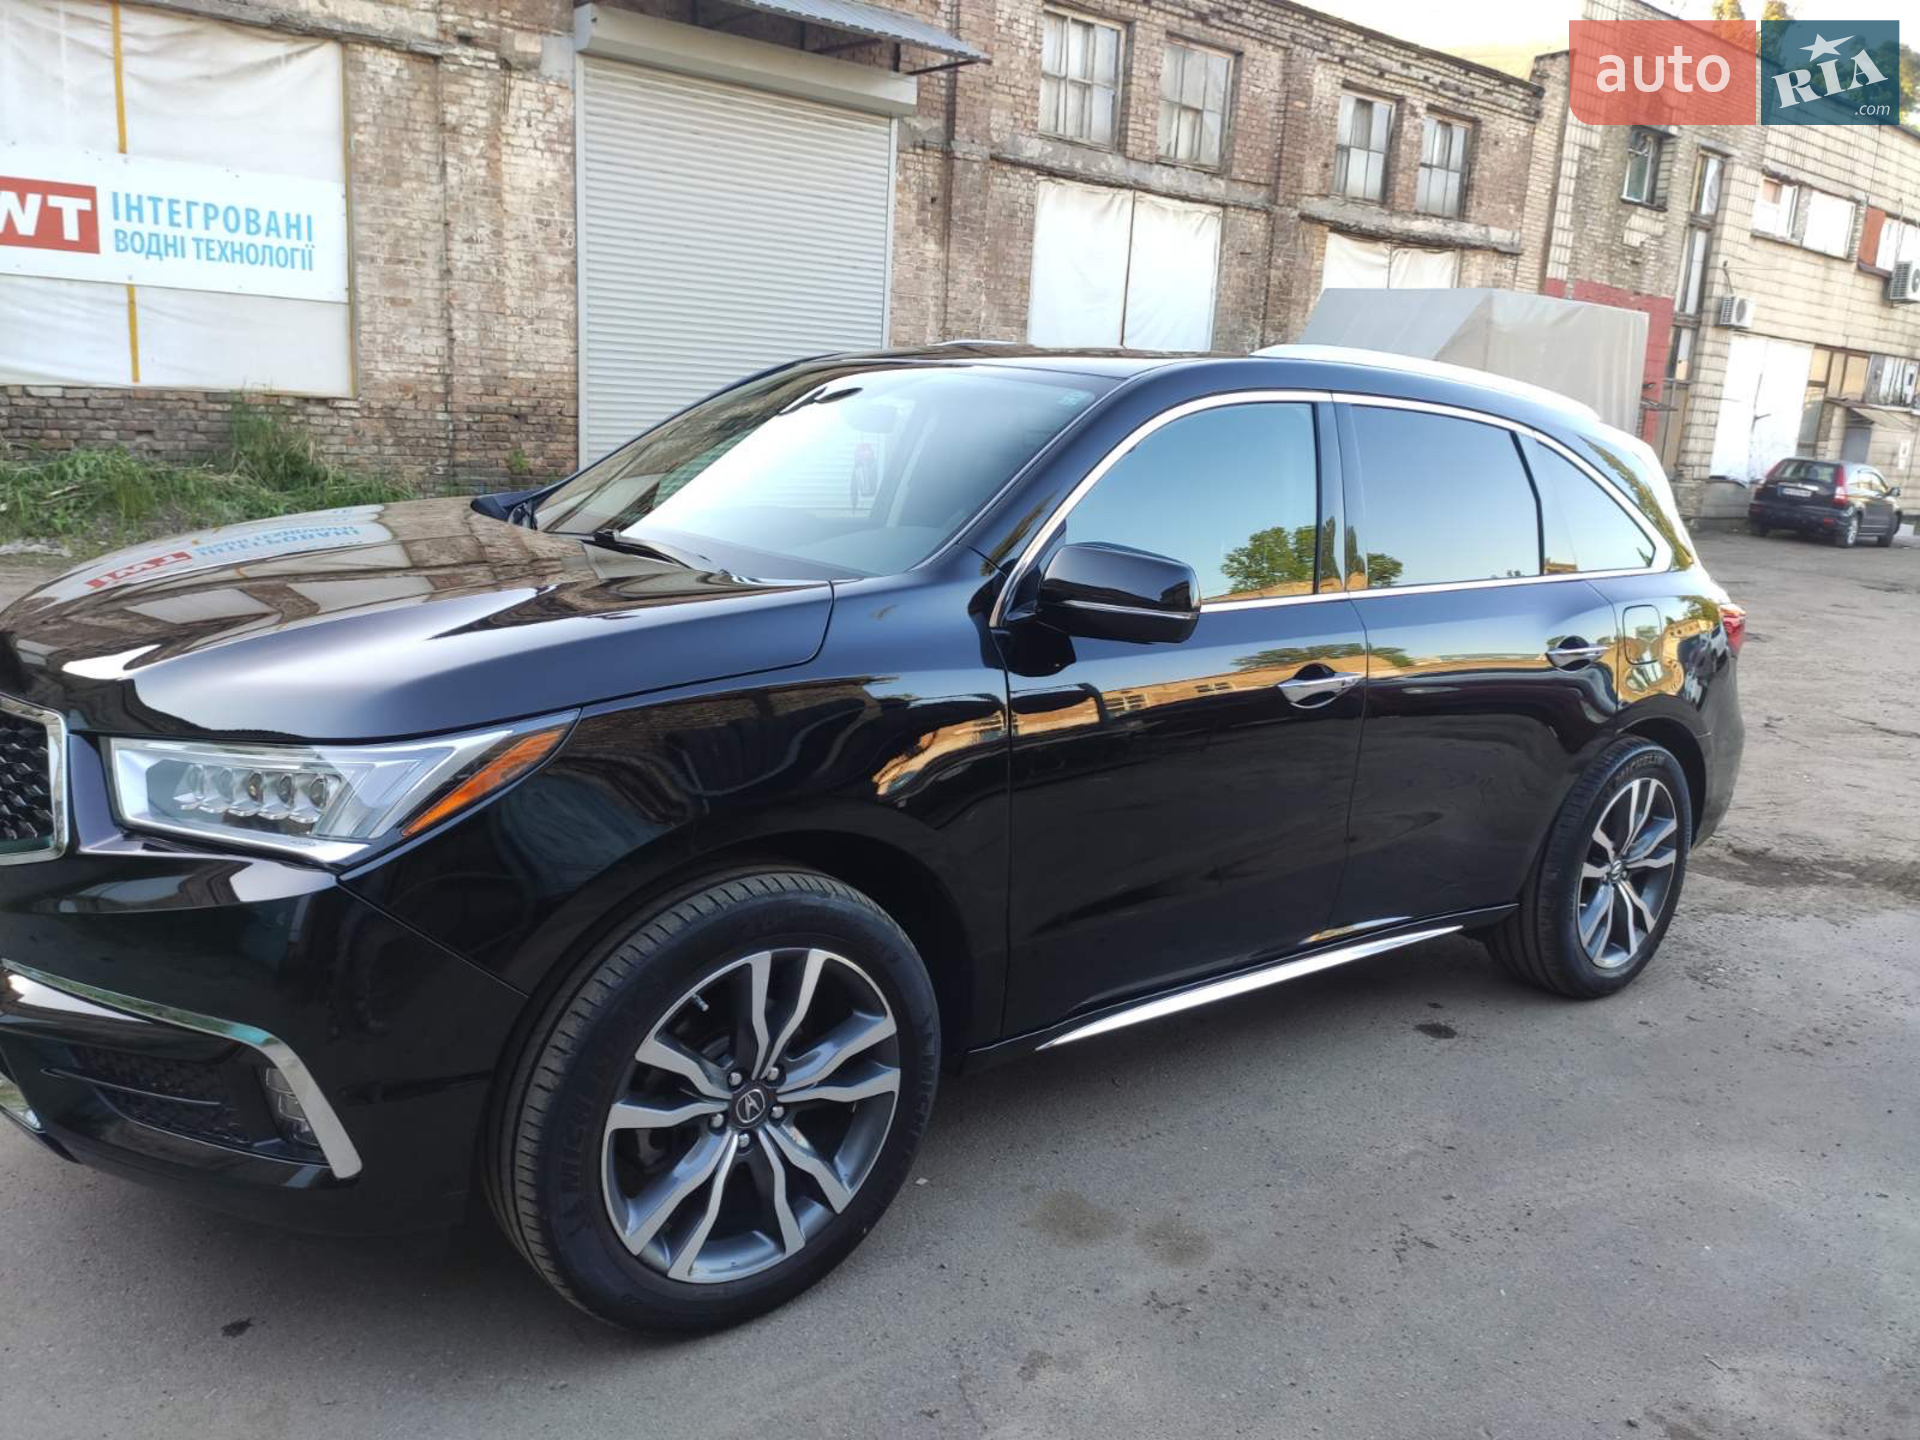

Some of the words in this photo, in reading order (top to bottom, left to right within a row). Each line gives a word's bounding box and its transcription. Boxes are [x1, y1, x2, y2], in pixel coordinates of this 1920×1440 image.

[112, 191, 313, 242] ІНТЕГРОВАНІ
[114, 228, 186, 262] ВОДНІ
[191, 237, 316, 271] ТЕХНОЛОГІЇ
